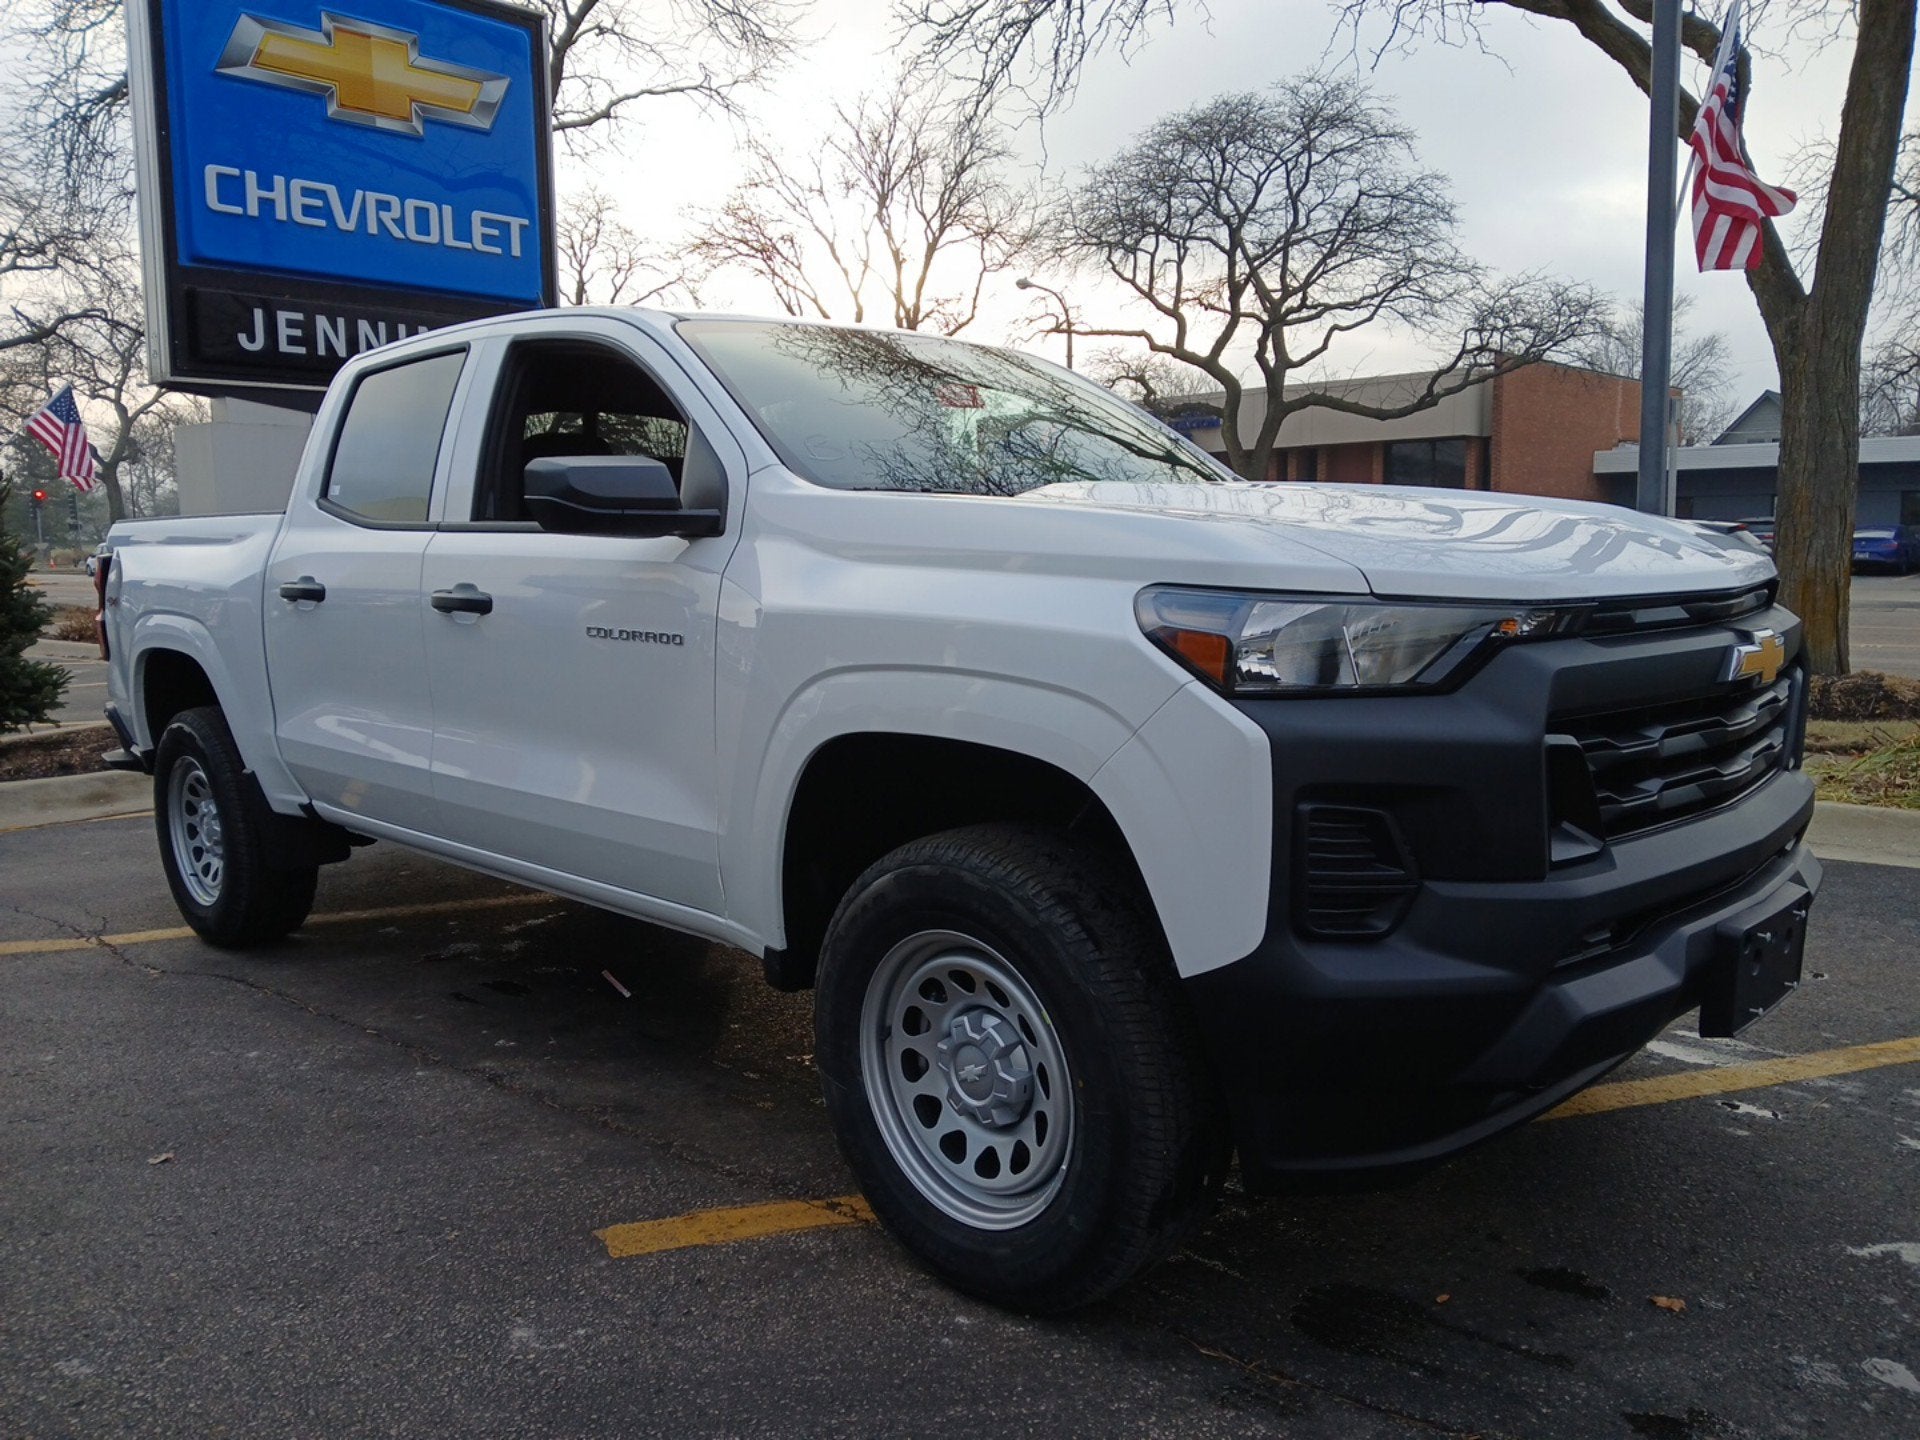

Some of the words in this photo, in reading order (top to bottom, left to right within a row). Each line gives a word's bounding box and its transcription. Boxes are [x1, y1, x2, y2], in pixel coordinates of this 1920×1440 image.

[204, 163, 529, 257] CHEVROLET
[237, 307, 429, 359] JENN
[586, 626, 684, 646] COLORADO
